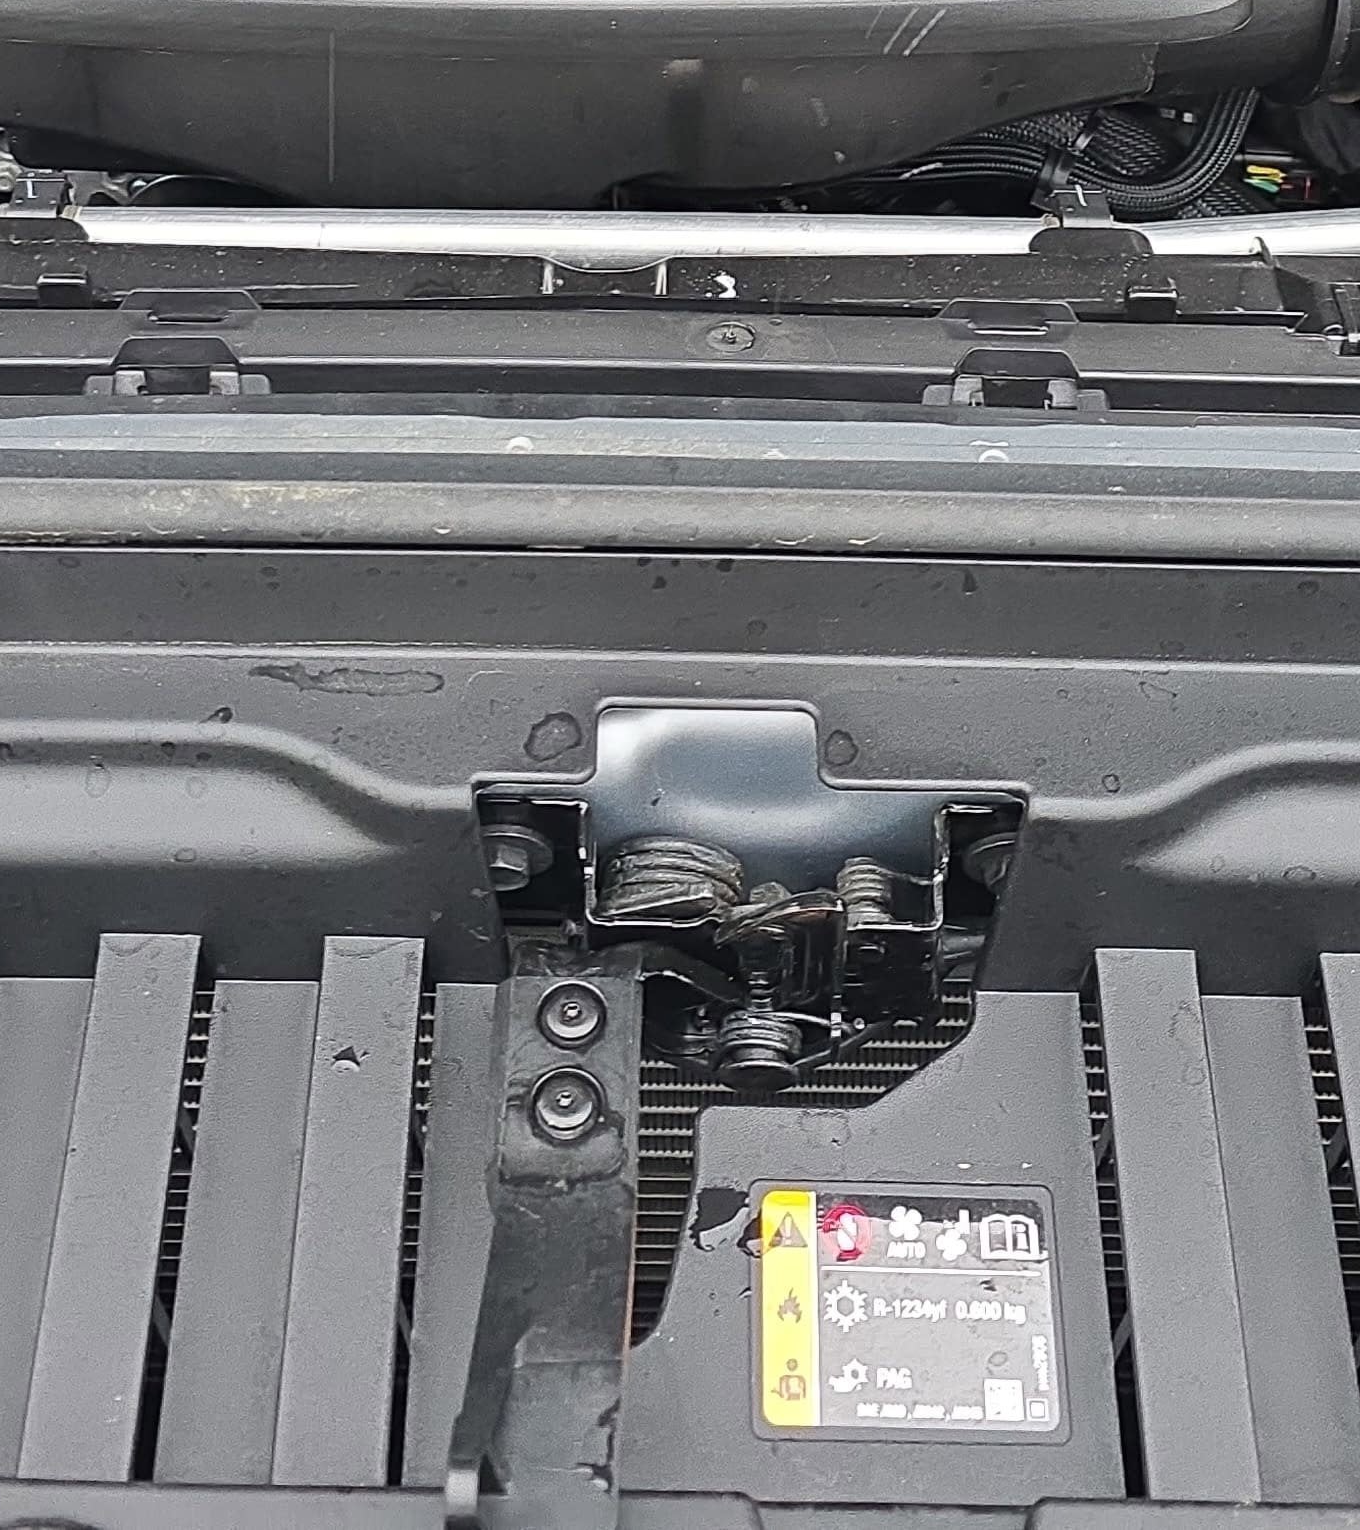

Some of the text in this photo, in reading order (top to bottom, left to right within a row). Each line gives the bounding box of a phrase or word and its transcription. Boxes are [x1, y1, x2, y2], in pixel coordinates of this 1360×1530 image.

[887, 1241, 926, 1259] AUTO
[873, 1298, 948, 1322] R-1234yf
[1004, 1302, 1026, 1324] kg
[876, 1367, 912, 1389] PAG
